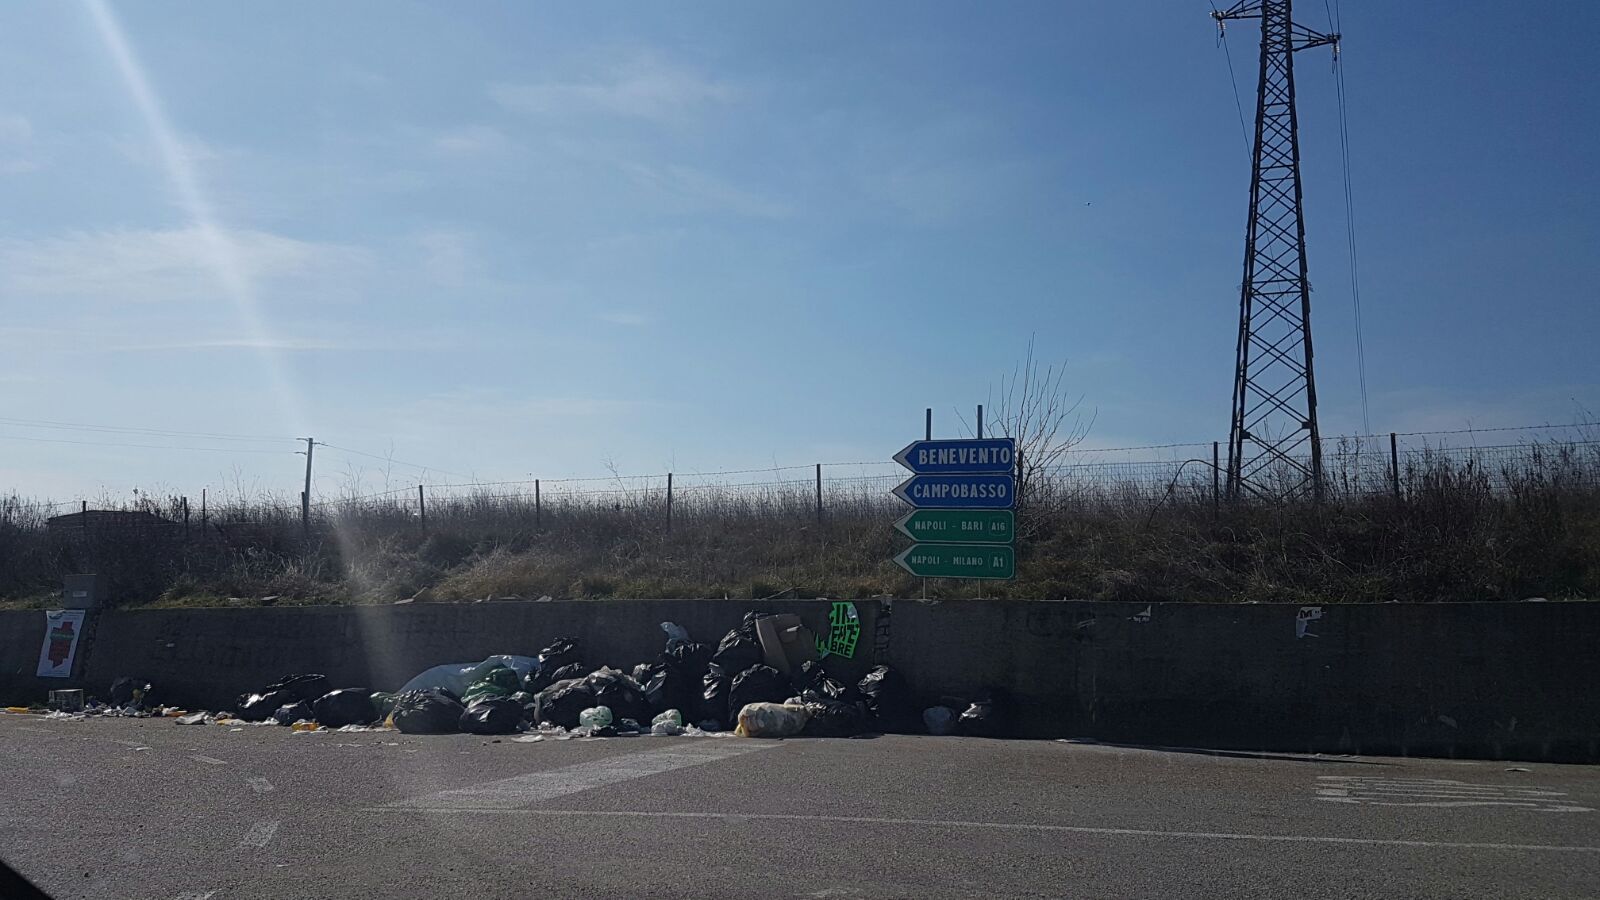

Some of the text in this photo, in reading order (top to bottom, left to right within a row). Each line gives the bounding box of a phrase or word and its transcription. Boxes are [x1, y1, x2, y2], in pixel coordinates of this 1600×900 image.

[919, 447, 1011, 465] BENEVENTO
[913, 483, 1007, 498] CAMPOBASSO
[914, 521, 946, 530] NAPOLI
[961, 521, 983, 530] BARI
[991, 522, 1006, 531] A16
[911, 556, 940, 565] NAPOLI
[953, 556, 983, 566] MILANO
[993, 558, 1004, 567] A1
